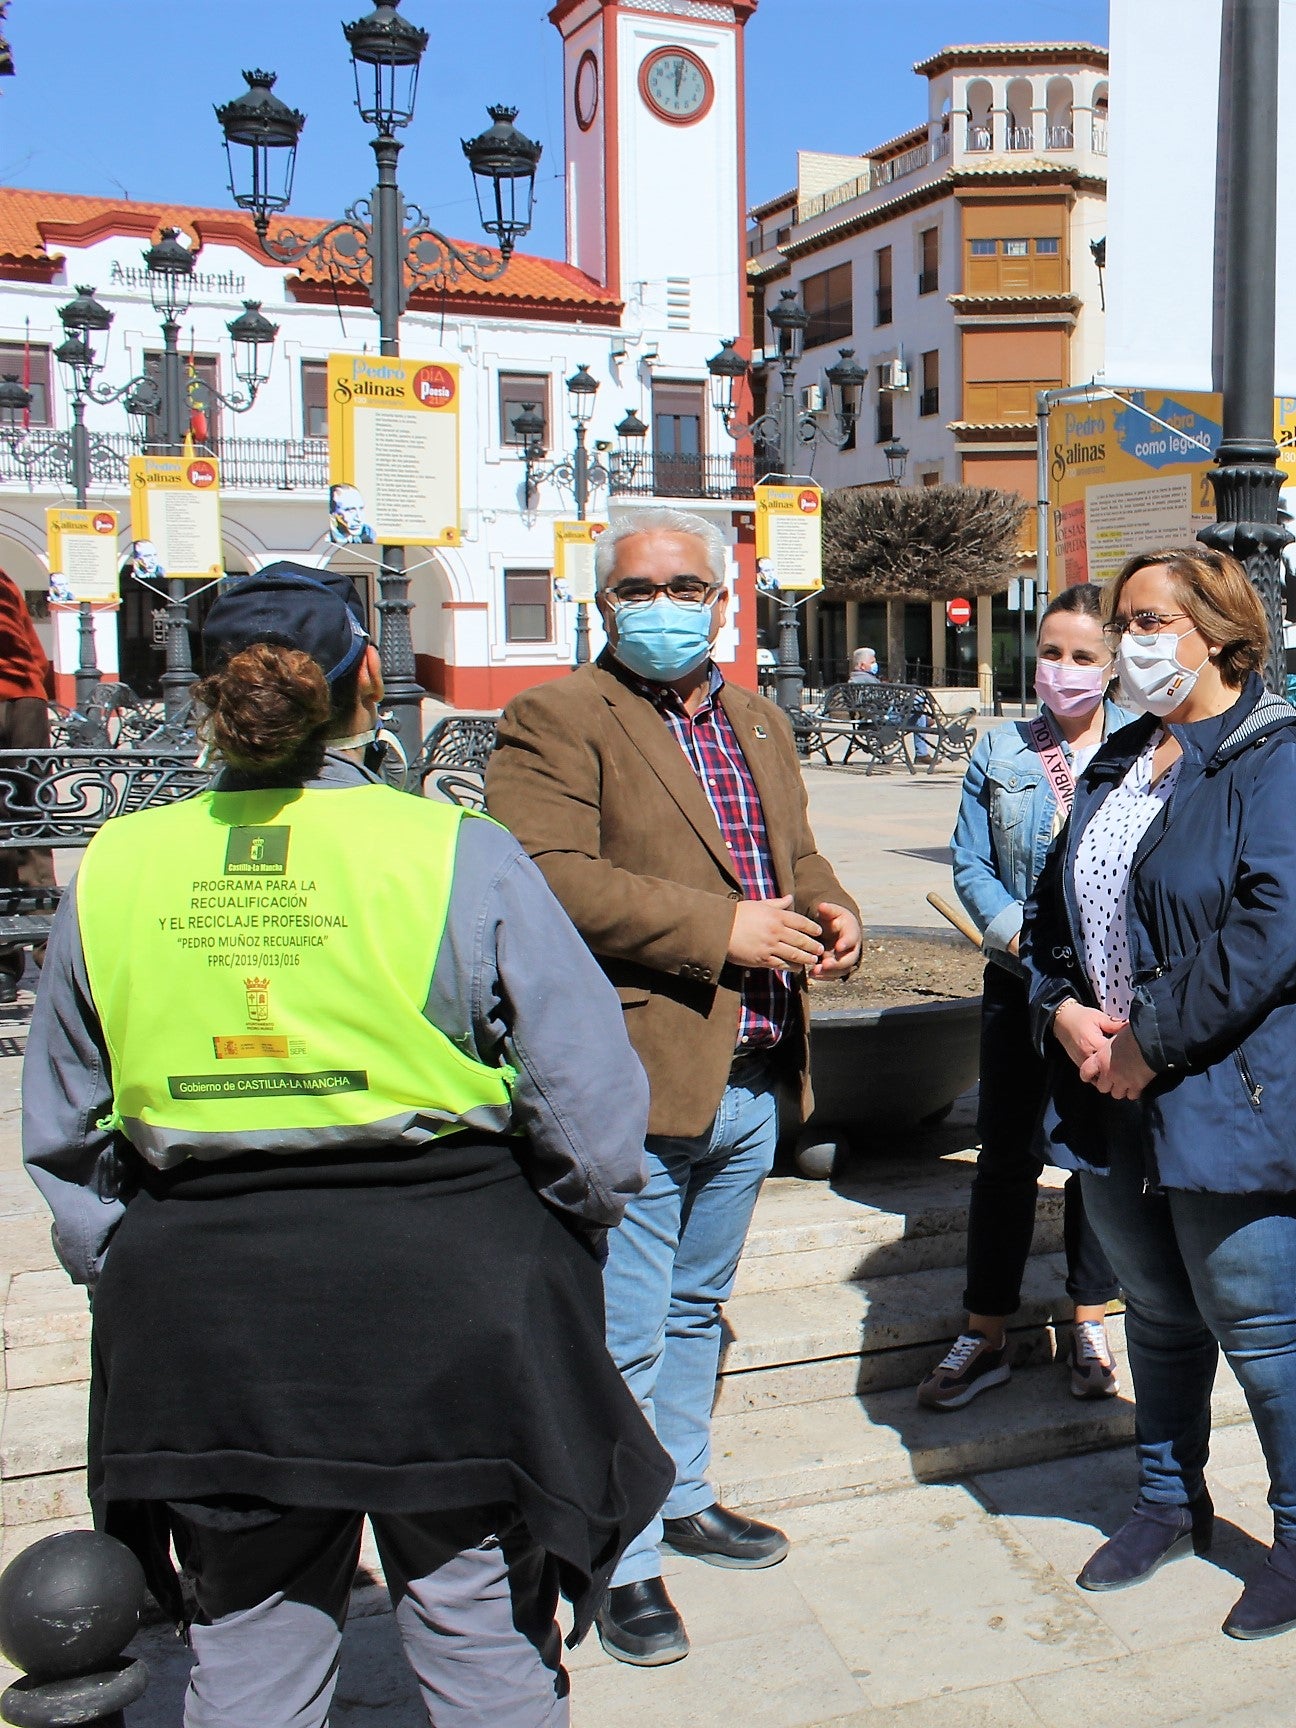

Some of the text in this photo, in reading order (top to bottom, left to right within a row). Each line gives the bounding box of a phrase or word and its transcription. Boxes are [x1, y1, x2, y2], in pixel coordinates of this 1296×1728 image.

[352, 358, 406, 381] Pedro
[334, 377, 405, 404] Salinas
[1064, 412, 1105, 446] Pedro
[1135, 439, 1167, 457] como
[1051, 443, 1106, 482] Salinas
[133, 472, 182, 489] Salinas
[192, 880, 316, 892] PROGRAMA PARA LA
[190, 894, 308, 909] RECUALIFICACIÓN
[158, 915, 349, 931] Y EL RECICLAJE PROFESIONAL
[218, 933, 260, 947] MUÑOZ
[208, 953, 300, 968] FPRC/2019/013/016
[290, 1047, 307, 1055] SEPE
[179, 1076, 350, 1093] Gobierno de CASTILLA-LA MANCHA
